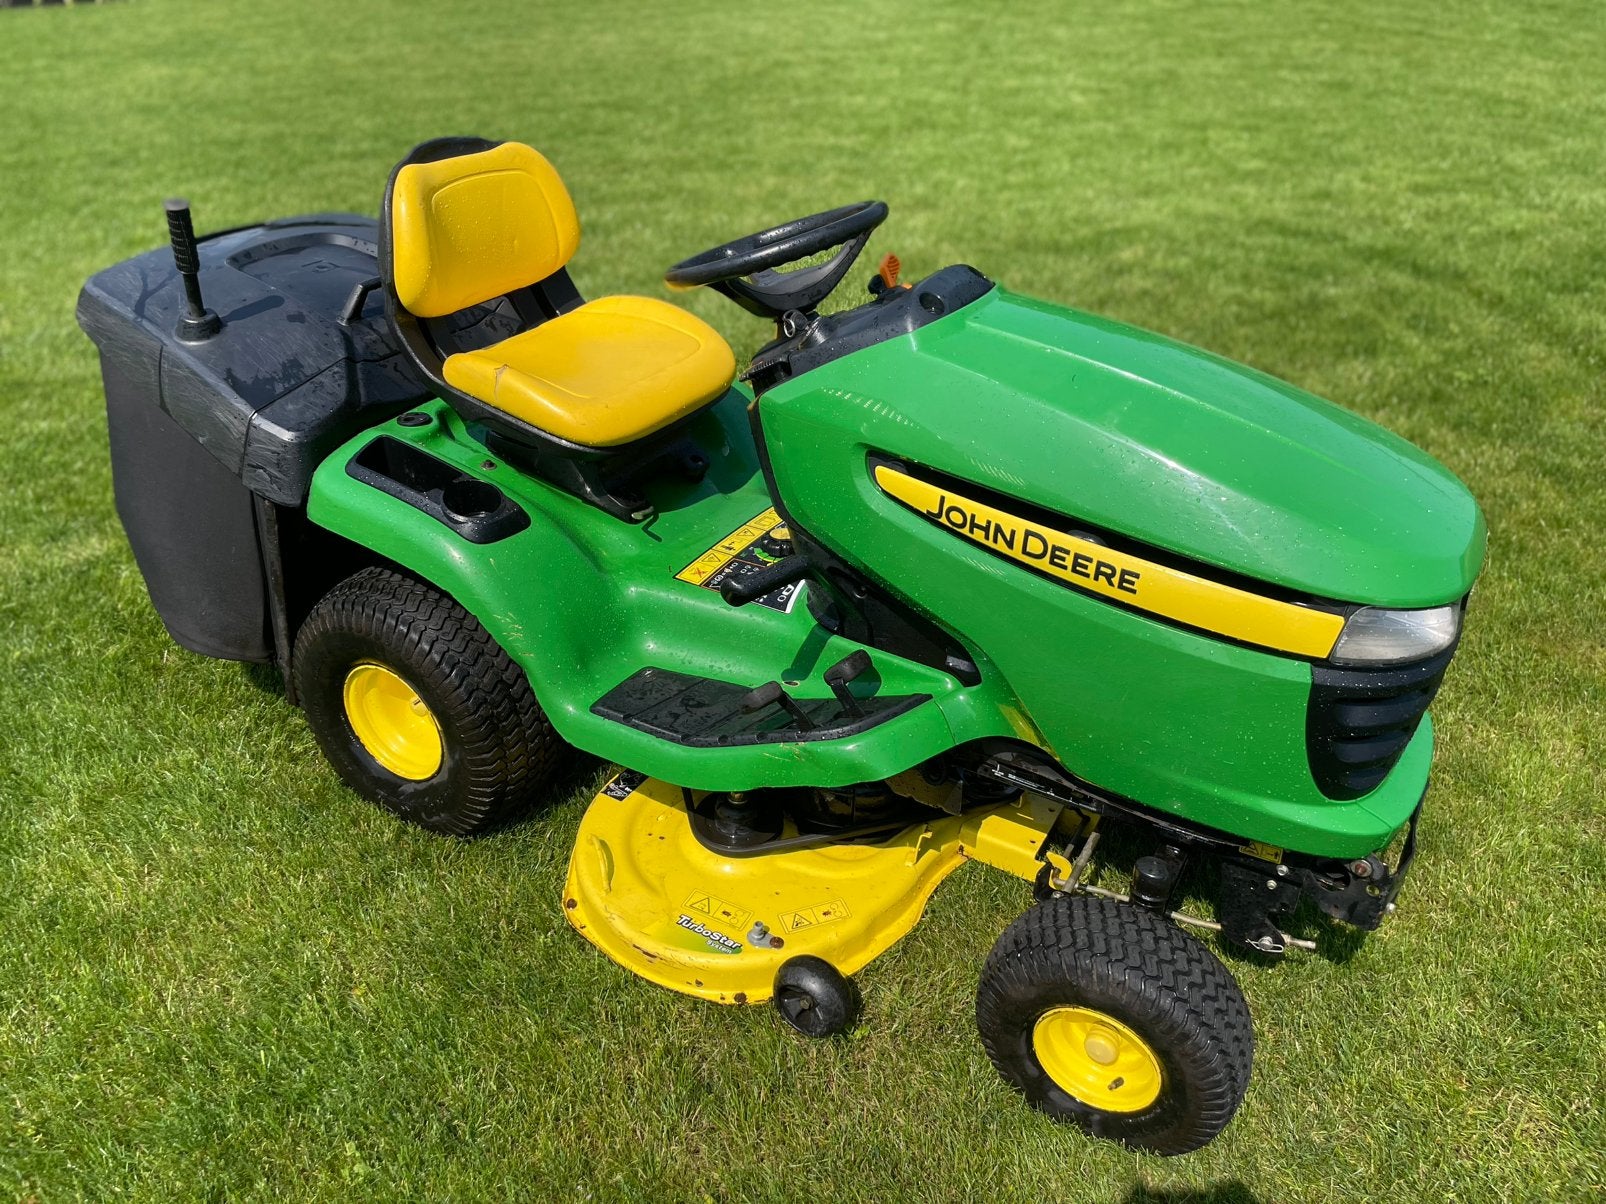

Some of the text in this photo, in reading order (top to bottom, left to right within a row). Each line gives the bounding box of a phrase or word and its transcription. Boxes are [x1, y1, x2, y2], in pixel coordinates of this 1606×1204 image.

[926, 495, 1140, 594] JOHN DEERE
[676, 914, 742, 949] TurboStar
